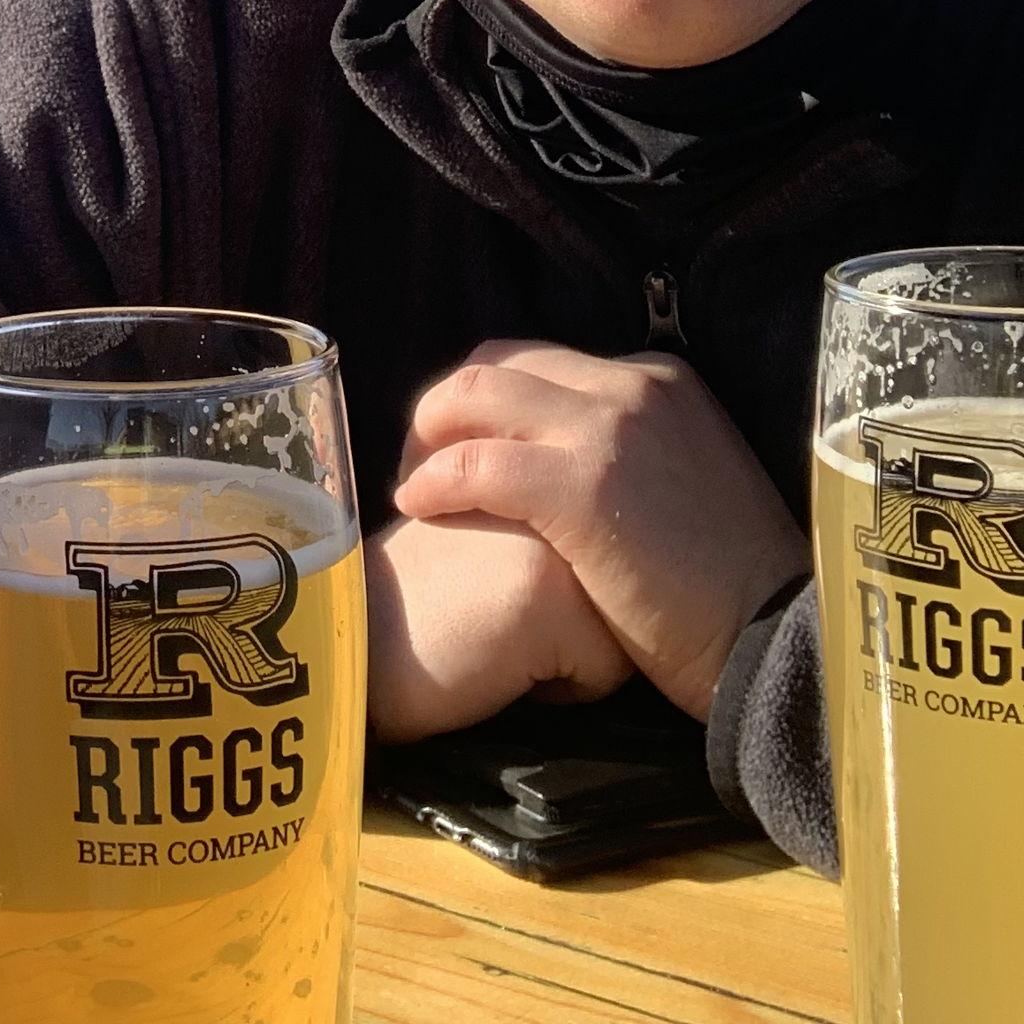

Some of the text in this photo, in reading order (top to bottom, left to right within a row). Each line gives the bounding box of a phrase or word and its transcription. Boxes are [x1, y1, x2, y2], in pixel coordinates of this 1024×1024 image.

[65, 532, 310, 720] R
[856, 579, 1024, 687] RIGG
[924, 690, 1024, 725] COMPA
[69, 716, 304, 825] RIGGS
[77, 817, 306, 866] BEER COMPANY
